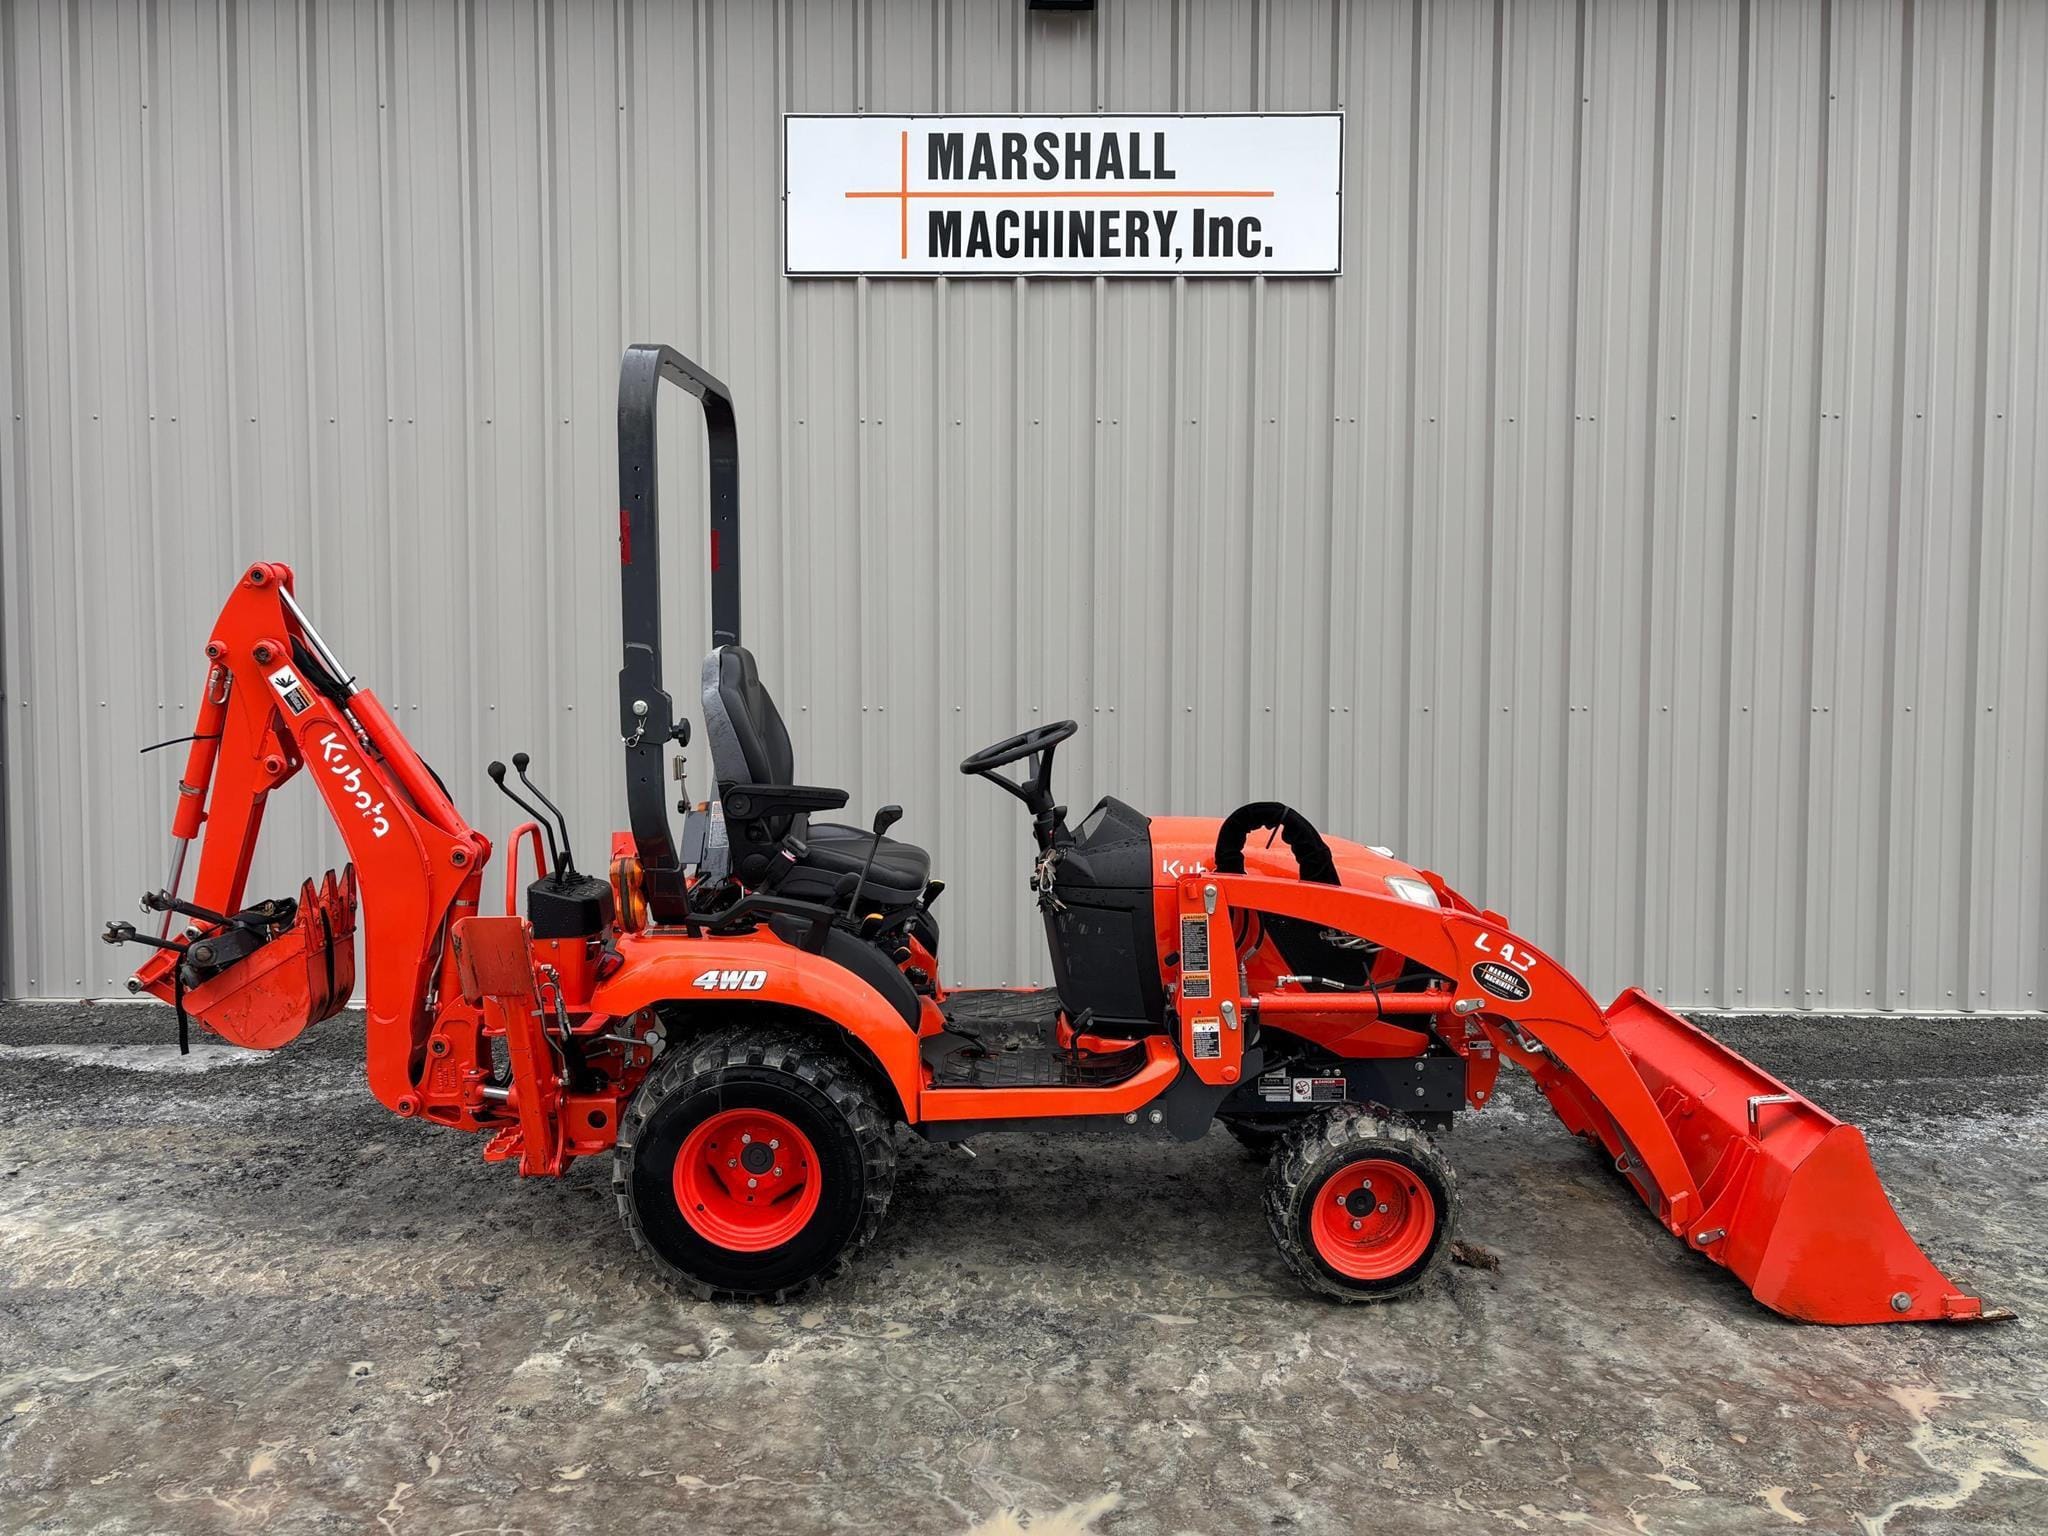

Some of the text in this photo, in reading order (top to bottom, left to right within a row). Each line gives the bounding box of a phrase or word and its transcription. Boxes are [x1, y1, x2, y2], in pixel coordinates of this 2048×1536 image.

[928, 132, 1176, 180] MARSHALL
[928, 208, 1273, 263] MACHINERY, Inc.
[319, 732, 390, 838] Kubota
[692, 969, 768, 991] 4WD
[1488, 966, 1518, 985] MARSHALL
